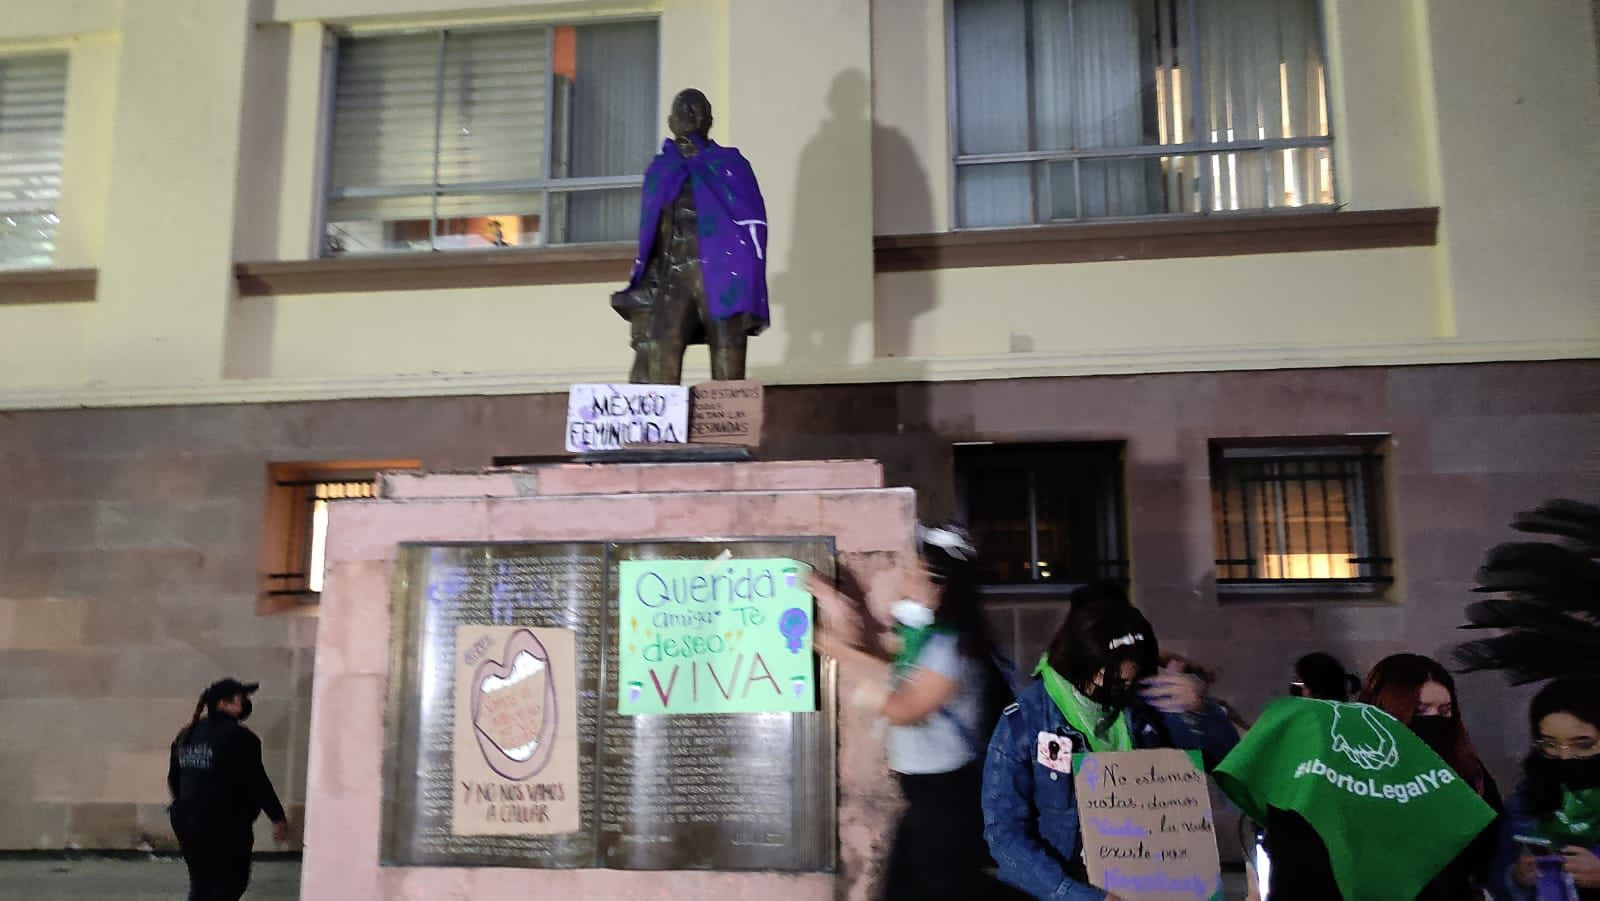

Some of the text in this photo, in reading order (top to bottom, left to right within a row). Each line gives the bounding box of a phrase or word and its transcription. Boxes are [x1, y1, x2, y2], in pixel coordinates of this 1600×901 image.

[569, 421, 682, 447] FEMINICIDA
[635, 567, 776, 608] Querida
[642, 633, 725, 662] deseo
[649, 652, 783, 707] VIVA
[1103, 763, 1202, 789] No estamos
[461, 782, 565, 804] Y NO NOS VAMOS
[485, 803, 551, 823] A CALLAR
